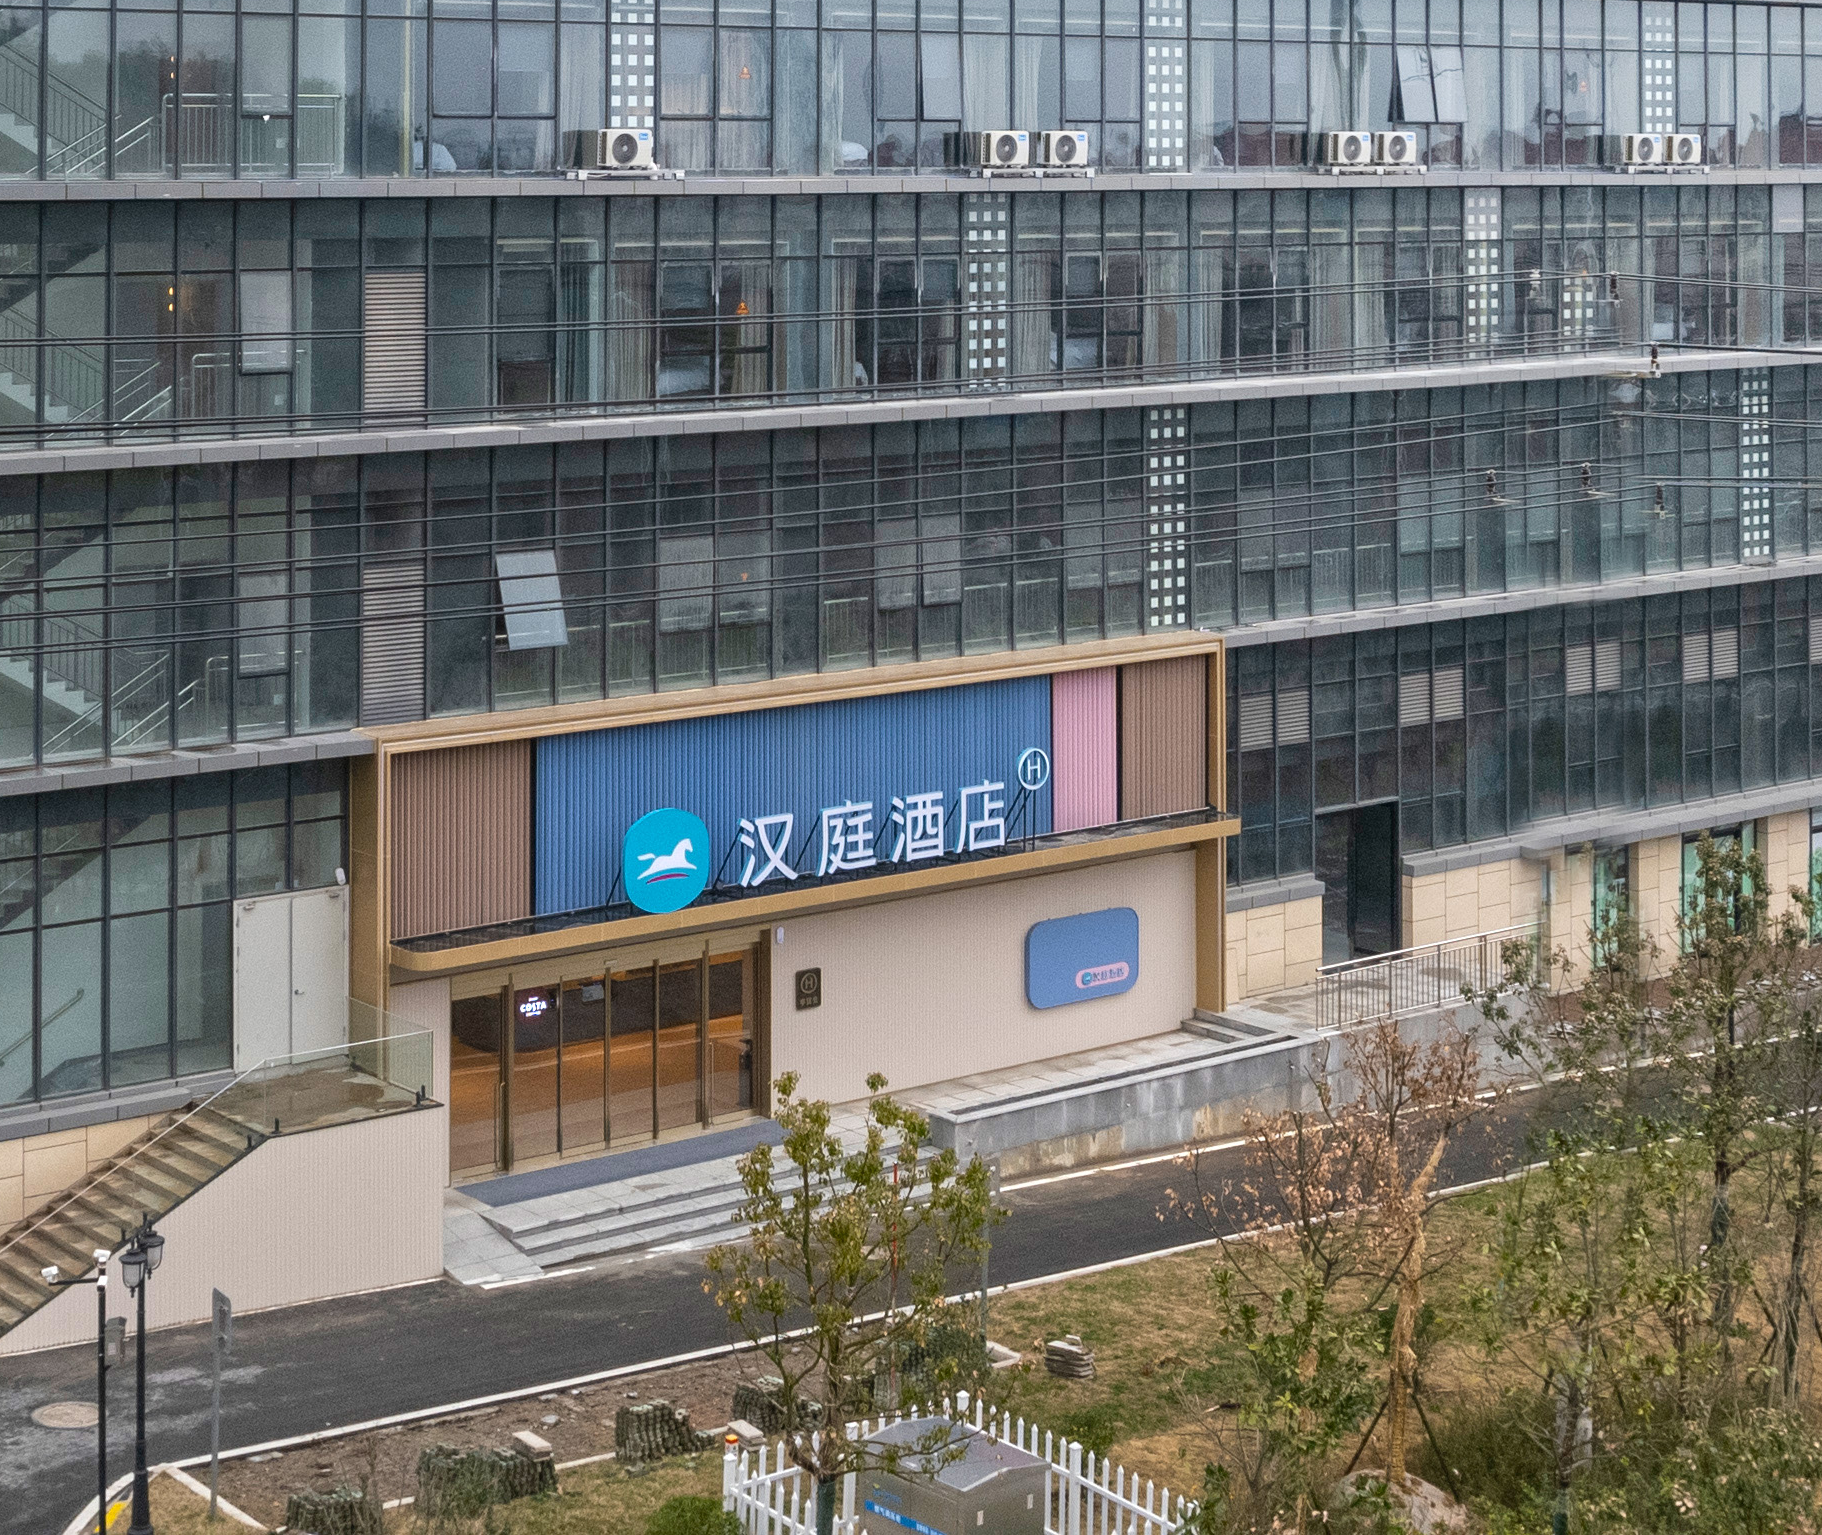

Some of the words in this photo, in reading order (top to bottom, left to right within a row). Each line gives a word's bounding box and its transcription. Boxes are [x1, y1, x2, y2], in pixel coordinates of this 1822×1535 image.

[737, 780, 1006, 887] 汉庭酒店
[520, 1001, 547, 1013] COSTA
